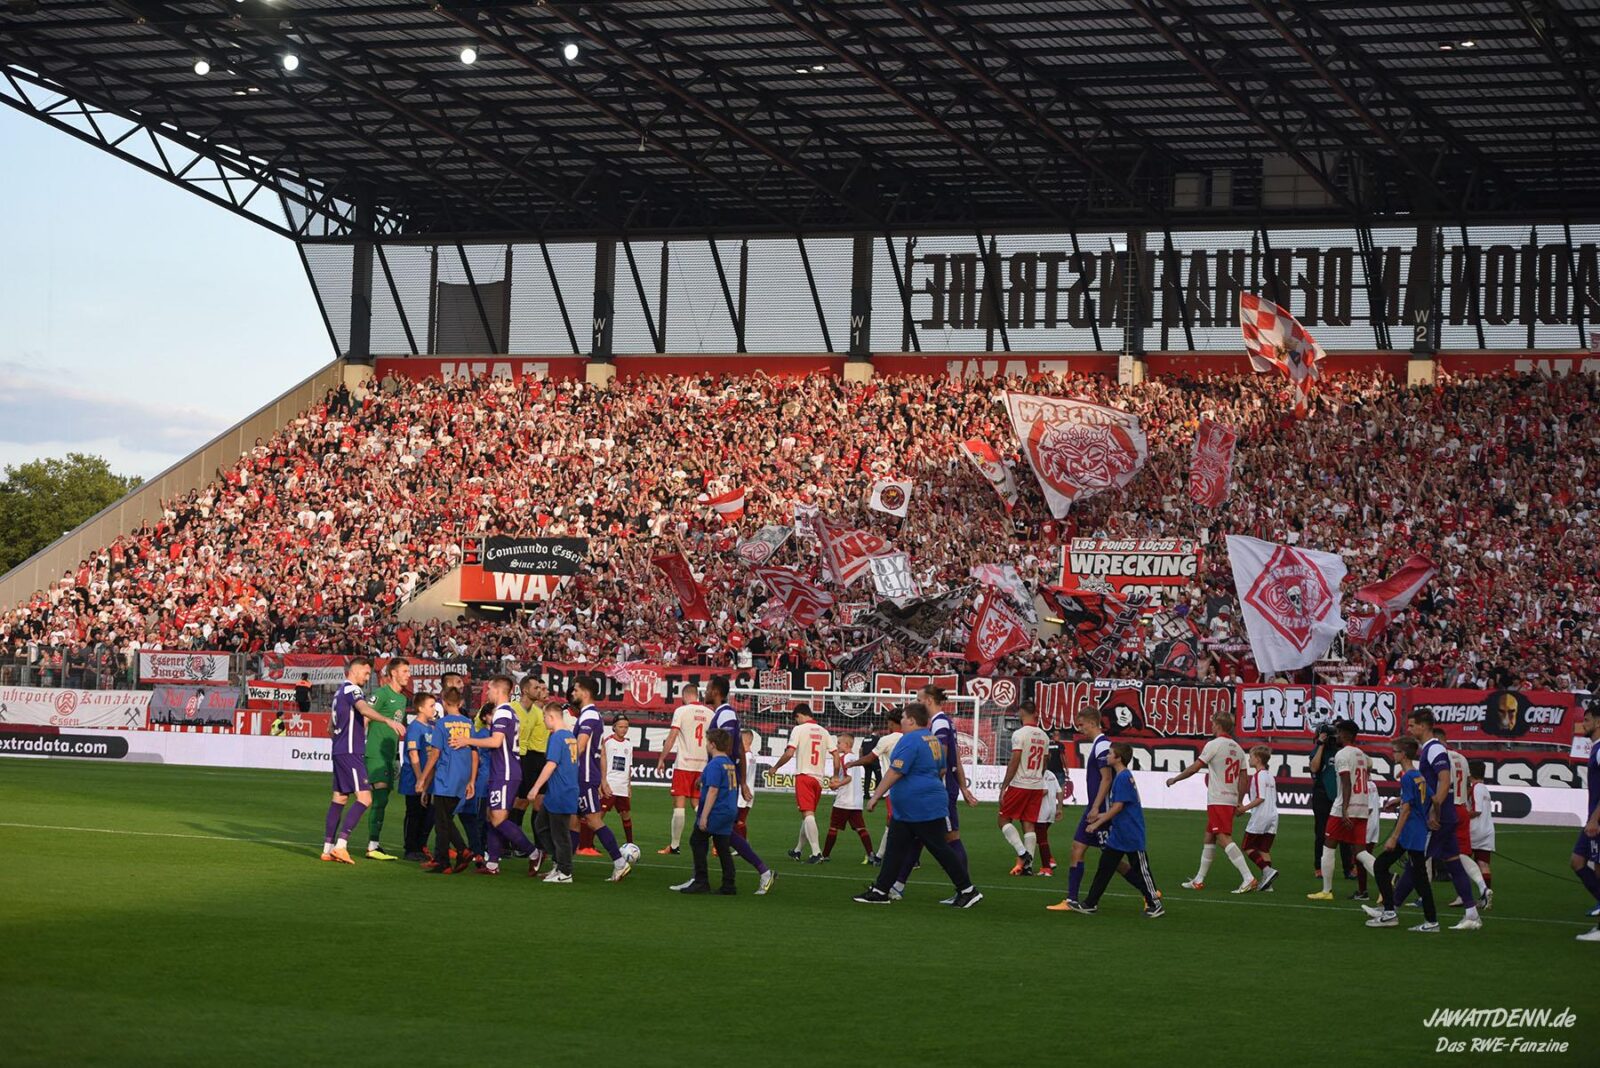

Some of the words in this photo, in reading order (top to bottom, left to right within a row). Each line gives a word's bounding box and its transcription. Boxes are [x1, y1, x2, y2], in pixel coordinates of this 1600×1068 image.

[486, 543, 548, 561] Commando
[1074, 540, 1095, 551] LOS
[509, 559, 535, 569] Since
[537, 559, 557, 569] 2012
[1069, 553, 1198, 576] WRECKING
[150, 655, 186, 667] Essener
[150, 666, 186, 678] Jungs
[249, 688, 271, 699] West
[1524, 706, 1565, 725] CREW
[695, 723, 703, 747] 4
[810, 741, 820, 766] 5
[490, 790, 501, 803] 23
